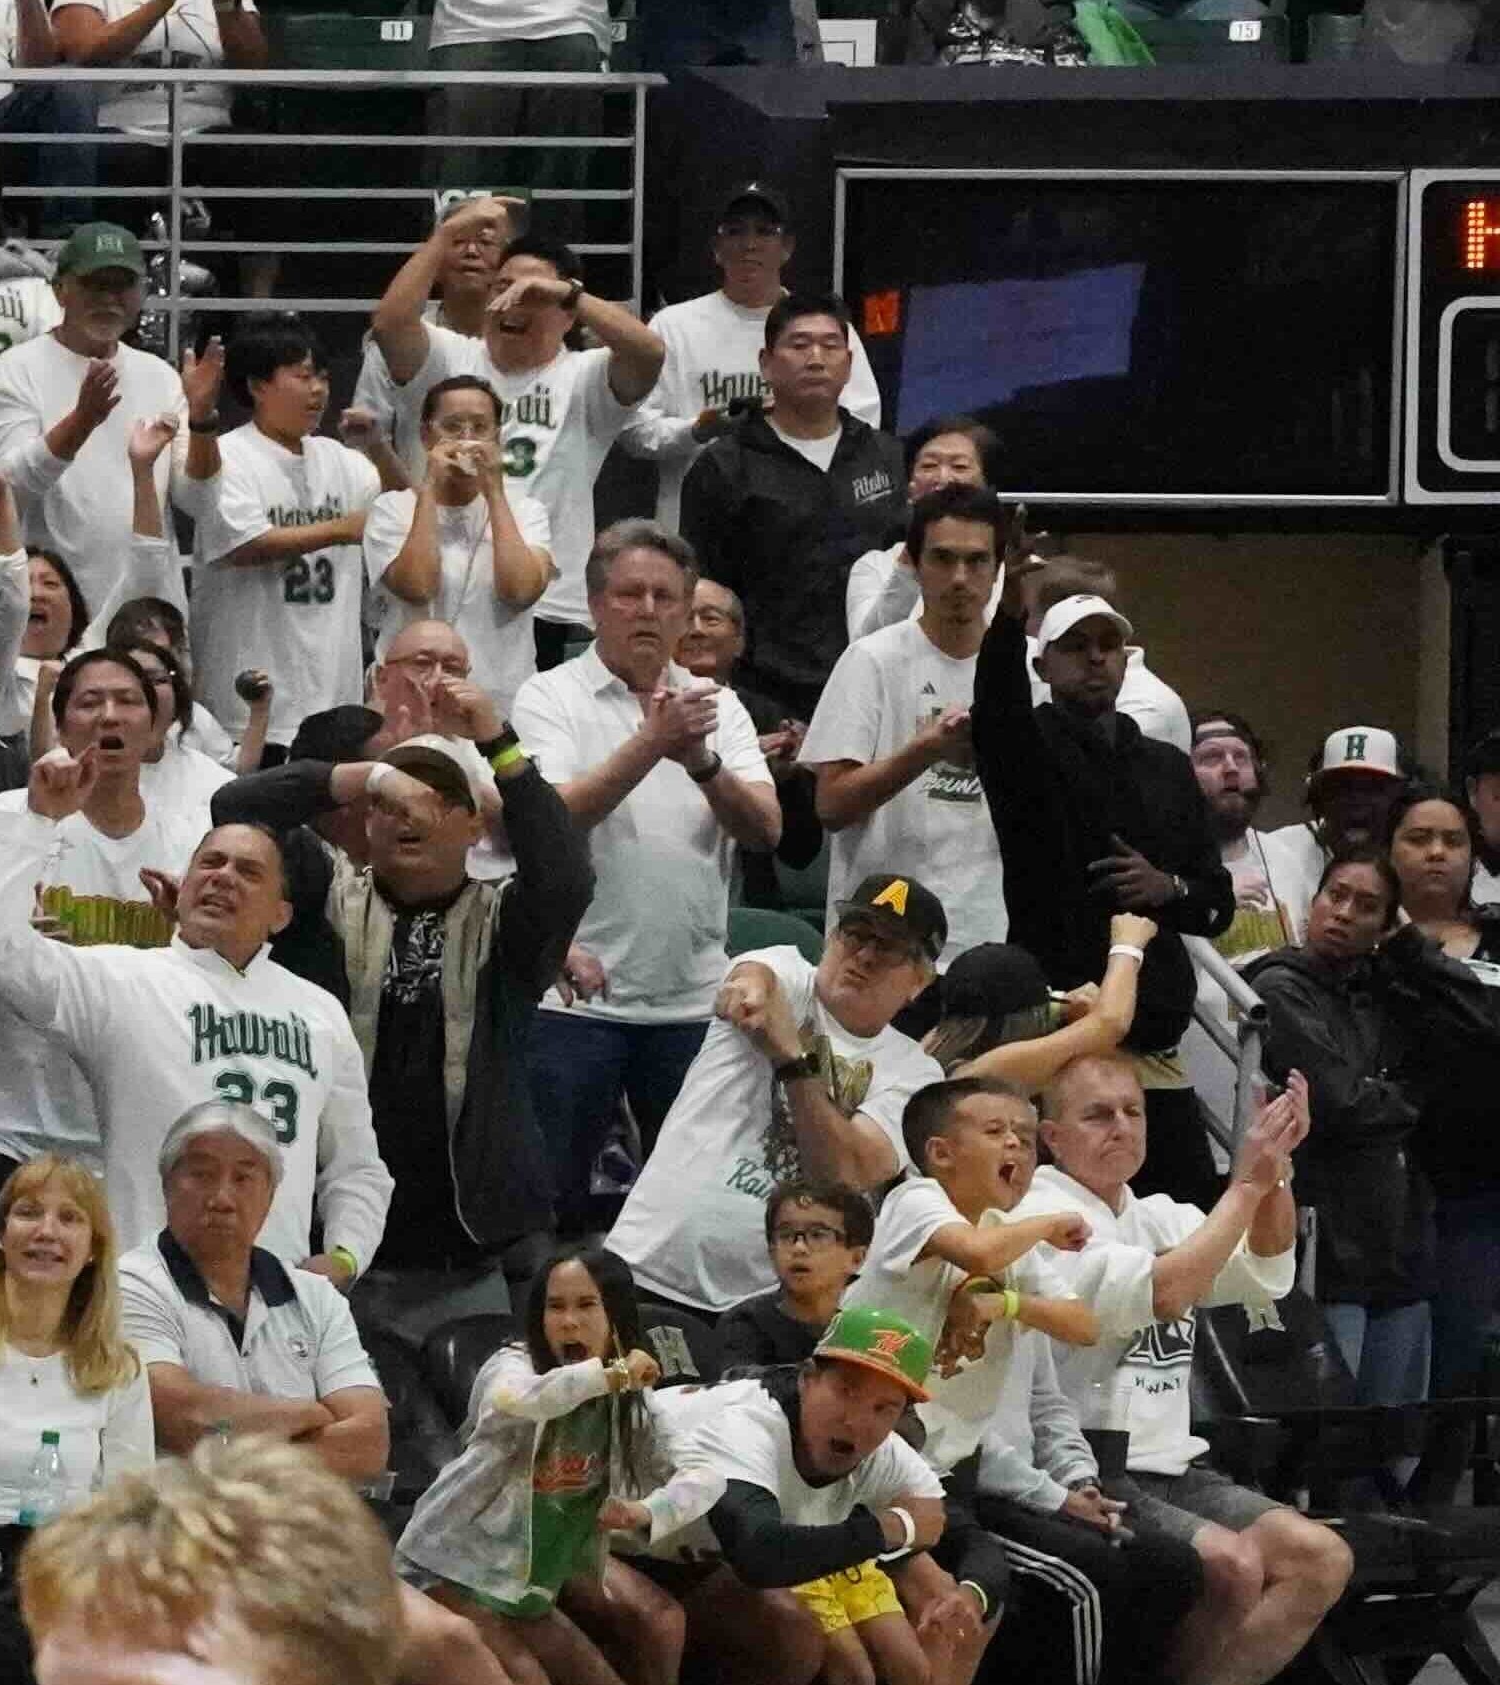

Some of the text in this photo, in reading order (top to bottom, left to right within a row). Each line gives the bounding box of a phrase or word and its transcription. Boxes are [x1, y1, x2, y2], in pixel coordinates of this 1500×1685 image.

[1343, 735, 1369, 761] H
[871, 879, 909, 917] A
[190, 1002, 318, 1081] Hawaii
